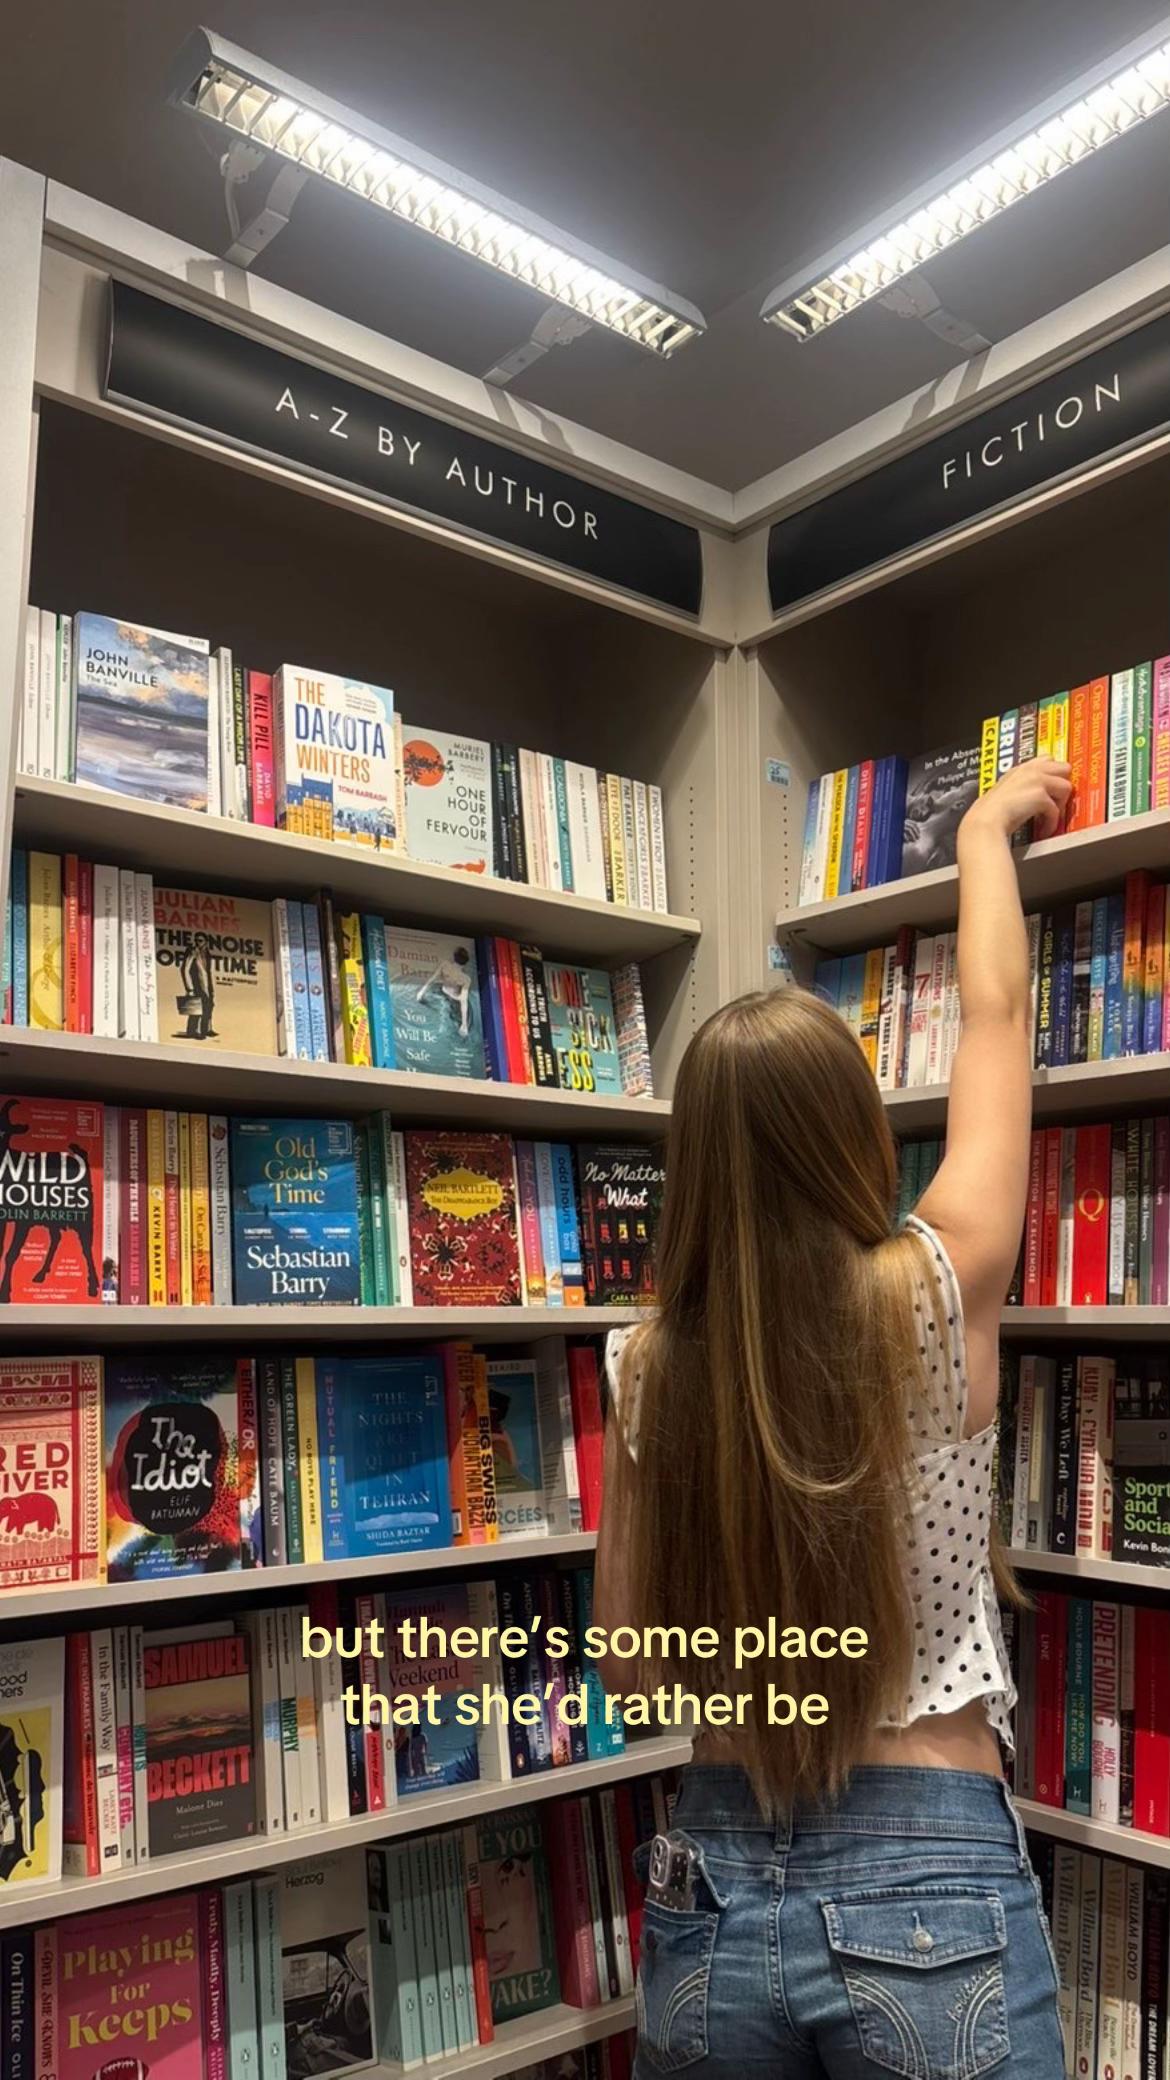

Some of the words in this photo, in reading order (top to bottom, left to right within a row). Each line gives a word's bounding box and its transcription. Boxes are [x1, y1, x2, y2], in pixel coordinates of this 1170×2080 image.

[942, 373, 1121, 489] FICTION
[275, 387, 348, 439] A-Z
[378, 426, 421, 464] BY
[446, 458, 598, 539] AUTHOR
[86, 647, 129, 667] JOHN
[86, 662, 158, 688] BANVILLE
[295, 677, 325, 706] THE
[1074, 692, 1085, 718] One
[1093, 684, 1104, 710] One
[254, 693, 268, 719] KILL
[255, 725, 269, 751] PILL
[295, 703, 385, 759] DAKOTA
[1072, 723, 1083, 757] Small
[1092, 713, 1103, 747] Small
[925, 761, 933, 770] In
[935, 756, 949, 766] the
[952, 747, 981, 761] Absen
[999, 717, 1015, 774] BRID
[296, 744, 370, 783] WINTERS
[957, 760, 968, 770] of
[982, 727, 996, 795] CARETA
[1090, 751, 1101, 784] Voice
[1115, 747, 1127, 780] FATIMA
[448, 797, 486, 815] HOUR
[456, 785, 486, 801] ONE
[426, 819, 487, 841] FERVOUR
[469, 815, 486, 828] OF
[154, 890, 234, 914] JULIAN
[155, 908, 240, 932] BARNES
[156, 928, 193, 947] THE
[208, 934, 264, 956] NOISE
[388, 945, 438, 962] Damian
[211, 955, 257, 976] TIME
[526, 967, 536, 1013] ACCORDING
[1039, 977, 1053, 1029] SUMMER
[402, 1009, 427, 1024] You
[531, 1015, 538, 1025] TO
[538, 997, 547, 1022] TRUTH
[396, 1028, 420, 1043] Will
[422, 1029, 437, 1044] Be
[533, 1028, 540, 1038] US
[406, 1048, 432, 1062] Safe
[167, 1119, 176, 1145] Kevin
[166, 1147, 177, 1173] Barry
[275, 1137, 316, 1159] Old
[1127, 1127, 1138, 1177] WHITE
[214, 1146, 226, 1202] Sebastian
[264, 1159, 329, 1182] God's
[558, 1157, 569, 1184] odd
[584, 1162, 610, 1182] No
[611, 1162, 666, 1183] Matter
[269, 1183, 326, 1204] Time
[427, 1184, 449, 1194] NEIL
[453, 1184, 498, 1194] BARTLETT
[603, 1184, 649, 1207] What
[33, 1209, 88, 1222] BARRETT
[561, 1188, 572, 1225] hours
[1078, 1189, 1105, 1222] Q
[1127, 1181, 1138, 1237] HOUSES
[153, 1206, 161, 1239] KEVIN
[215, 1205, 227, 1237] Barry
[153, 1245, 162, 1280] BARRY
[247, 1245, 350, 1269] Sebastian
[271, 1271, 330, 1299] Barry
[265, 1363, 276, 1394] LAND
[284, 1367, 292, 1387] THE
[1062, 1364, 1072, 1391] The
[241, 1368, 255, 1450] EITHER/OR
[266, 1398, 276, 1412] OF
[286, 1393, 294, 1431] GREEN
[325, 1375, 335, 1438] MUTUAL
[1059, 1396, 1071, 1423] Day
[151, 1417, 196, 1459] The
[267, 1418, 277, 1448] HOPE
[306, 1438, 312, 1450] NO
[479, 1416, 491, 1450] BIG
[1061, 1428, 1070, 1450] We
[463, 1432, 485, 1492] JONATHAN
[1080, 1419, 1097, 1485] CYNTHIA
[131, 1452, 213, 1492] Idiot
[268, 1457, 277, 1486] CATE
[328, 1445, 339, 1509] FRIEND
[1059, 1453, 1070, 1481] Left
[3, 1470, 68, 1493] IVER
[482, 1454, 497, 1525] SWISS
[151, 1507, 200, 1521] BATUMAN
[170, 1495, 191, 1506] ELIF
[269, 1490, 279, 1527] BAUM
[360, 1491, 432, 1510] TEHRAN
[468, 1496, 485, 1528] BAZZI
[1124, 1498, 1157, 1513] and
[1124, 1513, 1170, 1535] Socia
[1123, 1539, 1149, 1551] Kevin
[98, 1646, 110, 1657] In
[1040, 1634, 1050, 1661] LINE
[100, 1661, 110, 1680] the
[144, 1636, 248, 1688] SAMUEL
[1093, 1606, 1116, 1728] PRETENDING
[98, 1683, 112, 1723] Family
[100, 1725, 114, 1751] Way
[281, 1696, 299, 1753] MURPHY
[1071, 1717, 1077, 1732] ME
[1077, 1722, 1085, 1738] DO
[118, 1727, 132, 1794] COMPANY
[147, 1745, 251, 1802] BECKETT
[1093, 1740, 1104, 1780] BOURNE
[1104, 1747, 1116, 1778] HOLLY
[175, 1803, 204, 1816] Malone
[205, 1799, 223, 1810] Dies
[496, 1825, 543, 1853] YOU
[285, 1871, 325, 1889] Herzog
[1058, 1856, 1076, 1934] William
[1082, 1889, 1096, 1954] William
[1128, 1881, 1139, 1938] WILLIAM
[11, 1951, 24, 1976] On
[63, 1928, 194, 1981] Playing
[1127, 1942, 1138, 1981] BOYD
[41, 1951, 54, 1989] DEVIL
[1080, 1958, 1094, 2003] Boyd
[11, 1978, 25, 2016] Thin
[42, 1992, 53, 2017] SHE
[110, 1983, 151, 2005] For
[68, 1998, 193, 2049] Keeps
[210, 1990, 222, 2041] Deeply
[11, 2019, 24, 2043] Ice
[42, 2019, 54, 2068] KNOWS
[1148, 2020, 1156, 2051] DREAM
